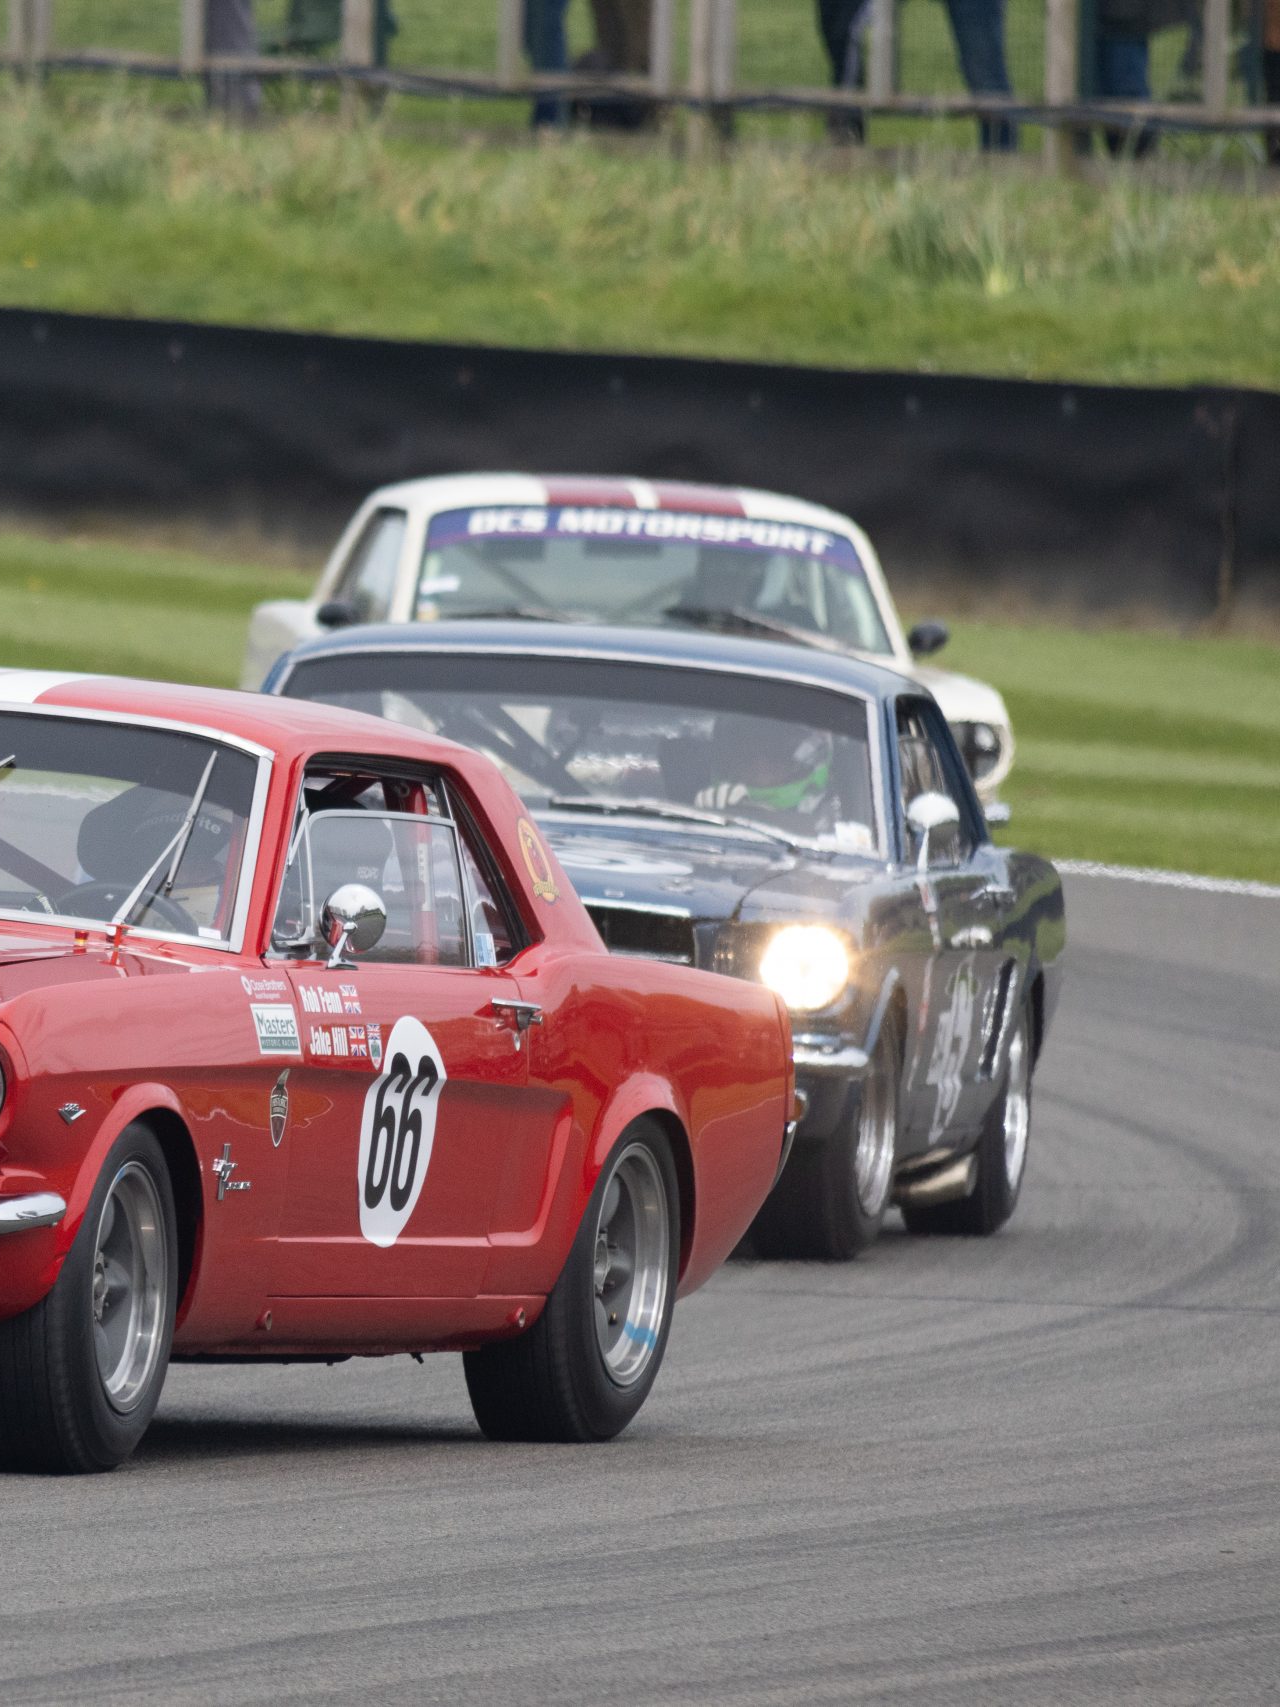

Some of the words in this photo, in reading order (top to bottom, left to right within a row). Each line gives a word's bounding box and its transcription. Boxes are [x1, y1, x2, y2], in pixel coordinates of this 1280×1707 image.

[468, 508, 547, 534] DCS
[557, 508, 835, 555] MOTORSPORT
[298, 985, 321, 1012] Rob
[317, 985, 343, 1014] Fenn
[255, 1011, 296, 1035] Masters
[310, 1026, 332, 1056] Jake
[331, 1027, 349, 1056] Hill
[364, 1051, 439, 1212] 66
